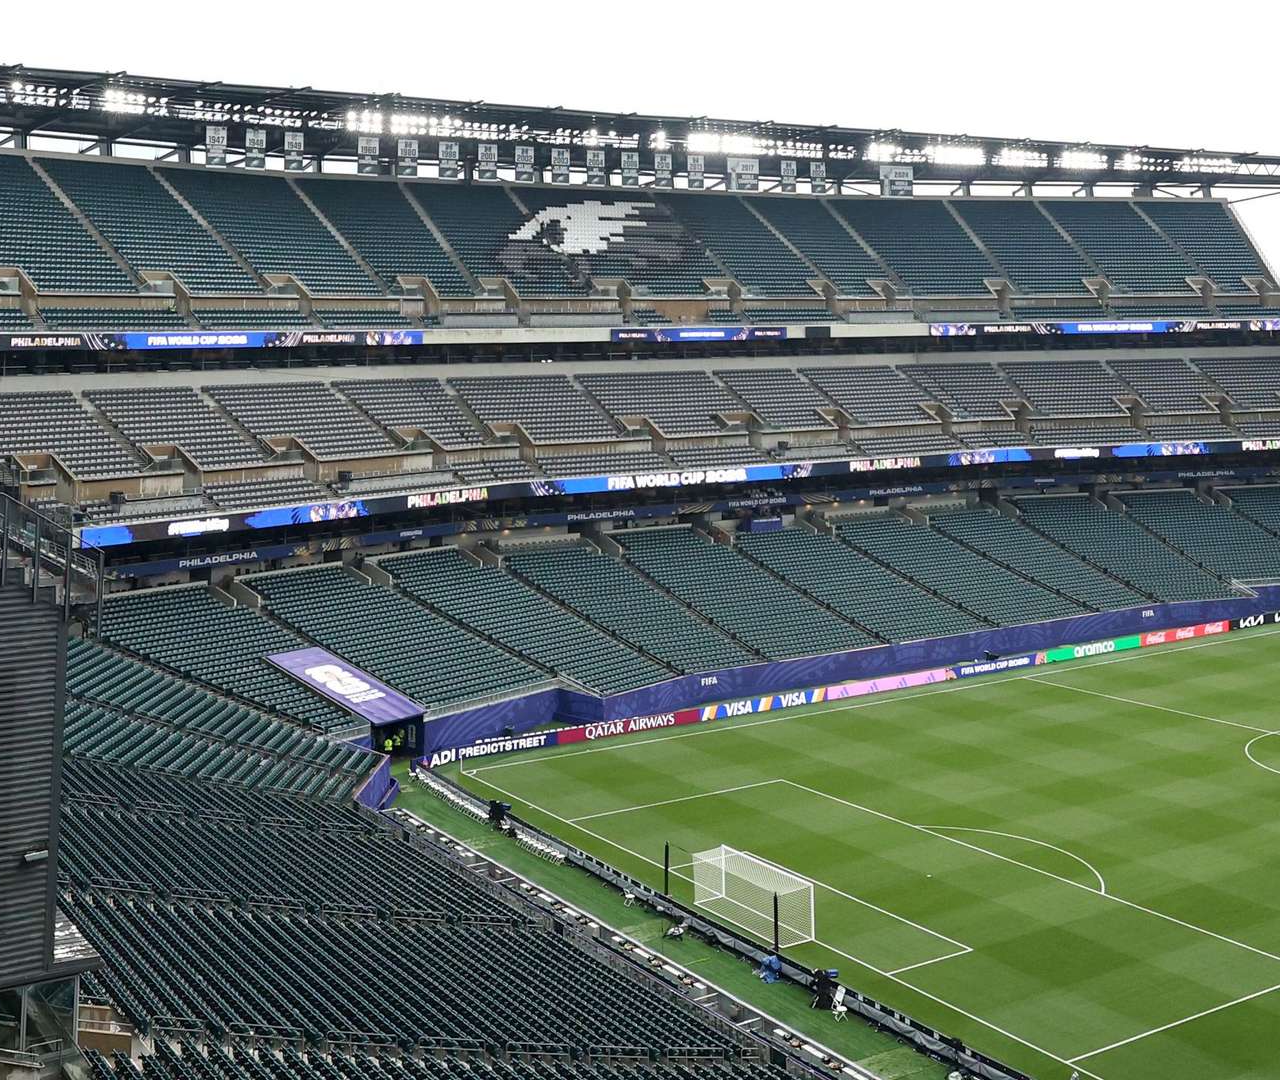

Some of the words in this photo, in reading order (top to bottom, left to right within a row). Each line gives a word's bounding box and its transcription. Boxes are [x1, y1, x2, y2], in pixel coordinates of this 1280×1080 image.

[208, 135, 225, 144] 1947
[248, 137, 264, 147] 1948
[287, 141, 302, 149] 1949
[400, 148, 417, 156] 1980
[480, 152, 496, 160] 2001
[11, 337, 81, 348] PHILADELPHIA
[168, 335, 200, 346] WORLD
[201, 335, 218, 345] CUP
[303, 334, 355, 343] PHILADELPHIA
[850, 457, 920, 472] PHILADELPHIA
[1178, 469, 1235, 478] PHILADELPHIA
[607, 477, 635, 491] FIFA
[635, 473, 680, 489] WORLD
[680, 471, 705, 485] CUP
[869, 485, 923, 496] PHILADELPHIA
[407, 487, 489, 509] PHILADELPHIA
[739, 499, 758, 507] WORLD
[758, 498, 769, 506] CUP
[568, 509, 635, 521] PHILADELPHIA
[179, 551, 258, 568] PHILADELPHIA
[1142, 609, 1155, 618] FIFA
[1074, 640, 1115, 657] aramco
[961, 667, 974, 676] FIFA
[974, 663, 996, 674] WORLD
[996, 660, 1008, 670] CUP
[701, 676, 718, 687] FIFA
[780, 691, 807, 708] VISA
[724, 700, 753, 717] VISA
[585, 721, 625, 739] QATAR
[628, 713, 675, 733] AIRWAYS
[430, 748, 456, 769] ADI
[459, 735, 547, 759] PREDICTSTREET
